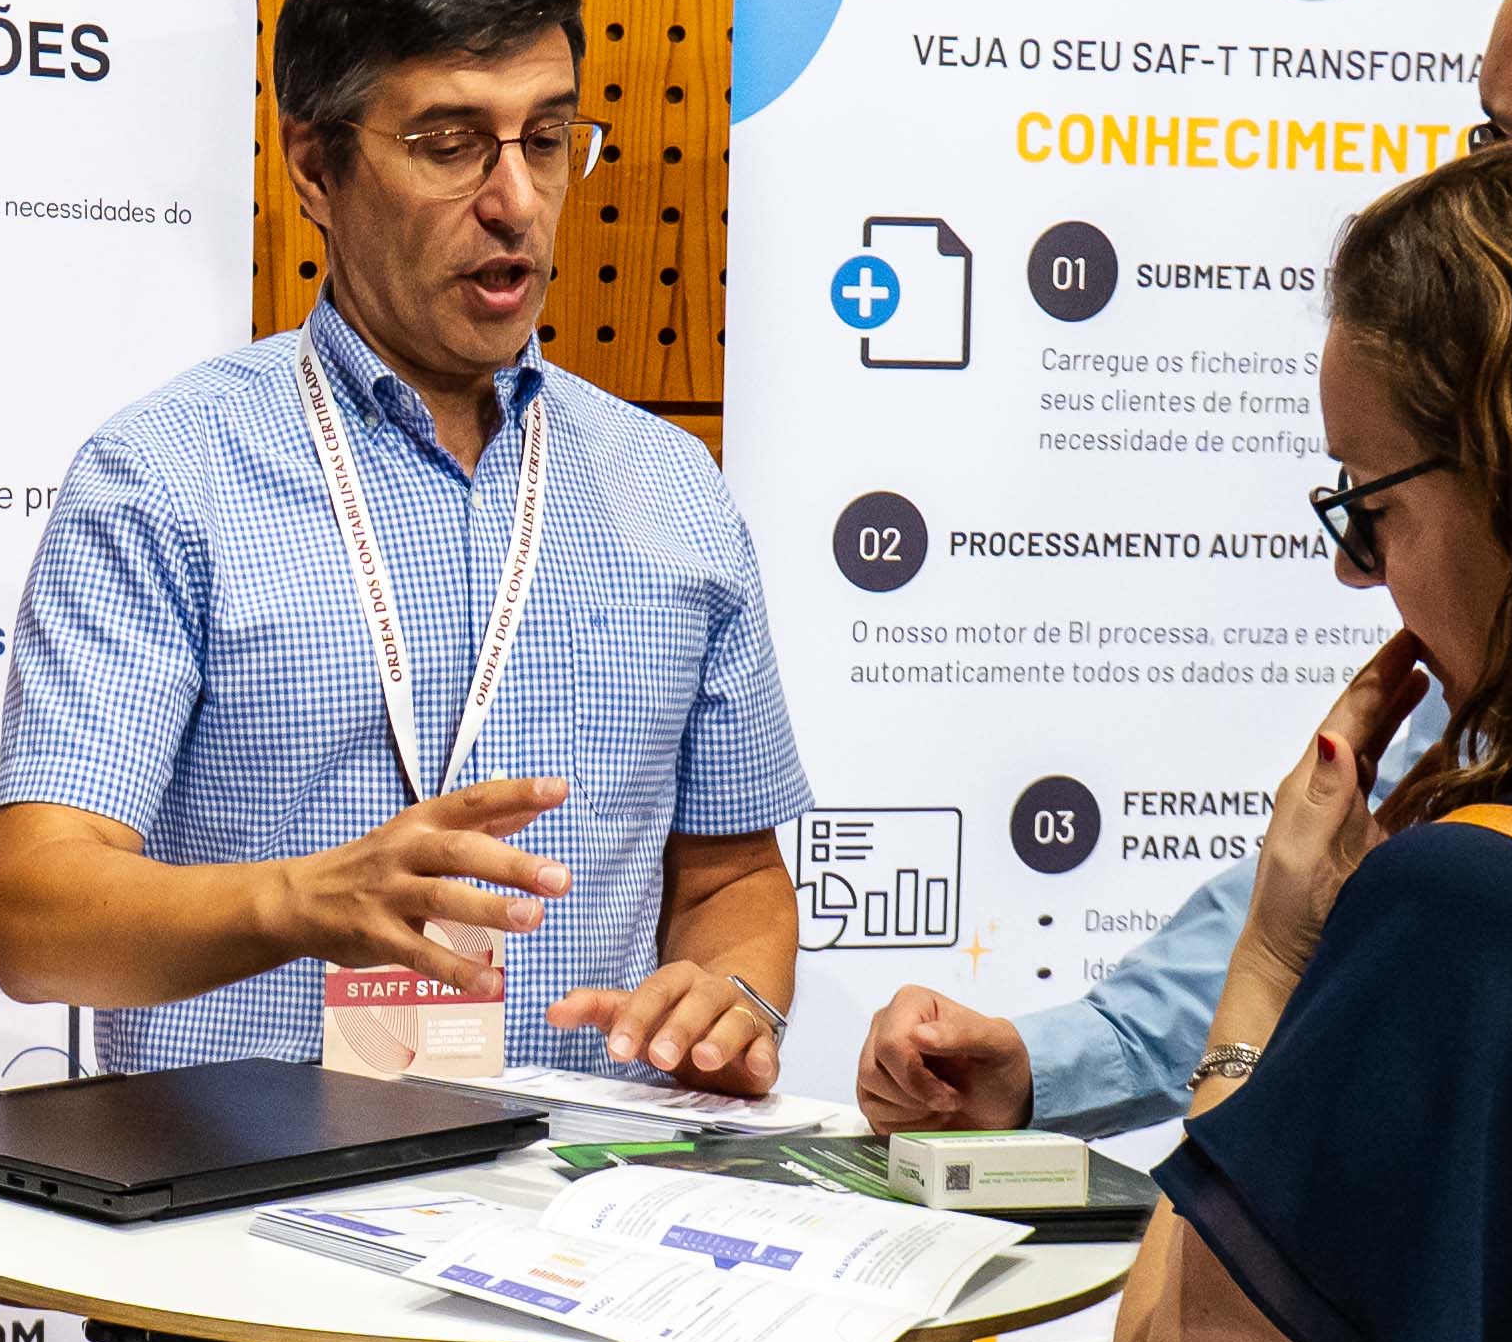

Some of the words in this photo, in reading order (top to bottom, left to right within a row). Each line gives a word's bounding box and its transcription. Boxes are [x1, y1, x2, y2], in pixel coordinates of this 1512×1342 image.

[915, 36, 1008, 69] VEJA
[1021, 40, 1041, 70] O
[1054, 41, 1121, 72] SEU
[1134, 44, 1236, 76] SAF-T
[7, 200, 156, 224] necessidades
[166, 203, 192, 225] do
[1054, 258, 1086, 291] 01
[1138, 265, 1272, 291] SUBMETA
[1282, 268, 1315, 292] OS
[1044, 349, 1149, 378] Carregue
[1158, 357, 1183, 373] os
[1193, 352, 1297, 375] ficheiros
[299, 355, 342, 453] CERTIFICADOS
[1042, 395, 1095, 411] seus
[1103, 391, 1196, 413] clientes
[1204, 393, 1232, 414] de
[1241, 393, 1310, 415] forma
[1038, 427, 1188, 454] necessidade
[1195, 429, 1224, 454] de
[1231, 429, 1328, 459] configu
[331, 455, 375, 576] CONTABILISTAS
[861, 528, 902, 561] 02
[952, 533, 1201, 559] PROCESSAMENTO
[367, 577, 388, 613] DOS
[475, 645, 502, 707] ORDEM
[495, 607, 513, 642] DOS
[506, 487, 537, 604] CONTABILISTAS
[376, 618, 403, 683] ORDEM
[852, 620, 867, 645] O
[875, 623, 946, 645] nosso
[955, 623, 1024, 645] motor
[1033, 620, 1060, 645] de
[1069, 621, 1091, 645] BI
[1098, 623, 1215, 650] processa,
[1223, 624, 1287, 646] cruza
[1295, 627, 1308, 645] e
[851, 660, 1064, 685] automaticamente
[1072, 660, 1140, 685] todos
[1148, 665, 1174, 685] os
[1182, 660, 1254, 685] dados
[1262, 660, 1288, 685] da
[1295, 665, 1335, 685] sua
[1036, 812, 1075, 845] 03
[1123, 834, 1200, 860] PARA
[1209, 835, 1246, 860] OS
[347, 981, 410, 997] STAFF
